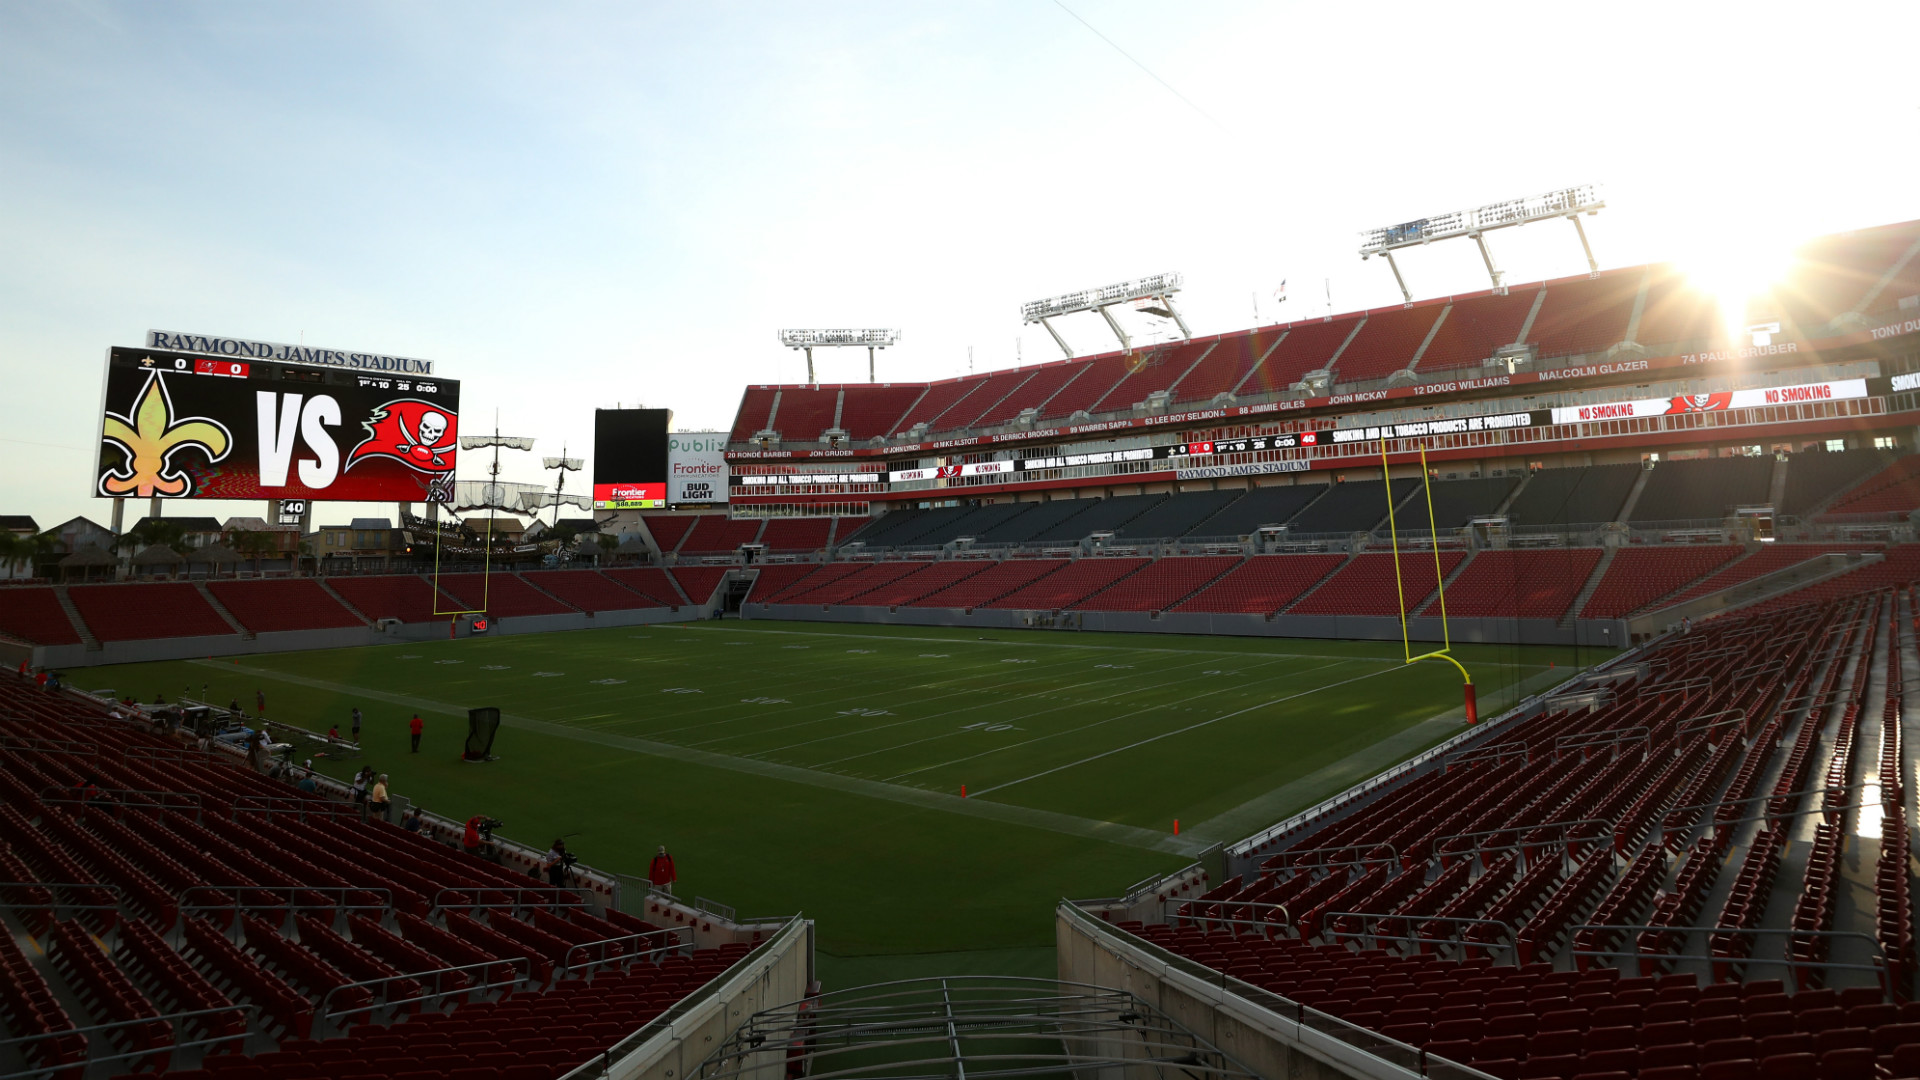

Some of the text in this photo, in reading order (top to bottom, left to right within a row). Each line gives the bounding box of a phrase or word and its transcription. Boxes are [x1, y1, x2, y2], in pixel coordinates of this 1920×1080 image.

[1871, 323, 1901, 340] TONY
[153, 332, 433, 375] RAYMOND JAMES STADIUM
[1682, 343, 1798, 366] 74 PAUL GRUBER
[175, 359, 186, 370] 0
[230, 364, 241, 375] 0
[1539, 360, 1649, 382] MALCOLM GLAZER
[379, 381, 390, 389] 10
[397, 383, 410, 391] 25
[416, 385, 437, 393] 0:00
[1414, 376, 1510, 396] 12 DOUG WILLIAMS
[1329, 390, 1388, 405] JOHN MCKAY
[1765, 385, 1832, 404] NO SMOKING
[1239, 400, 1306, 415] 88 JIMMIE GILES
[1579, 403, 1634, 421] NO SMOKING
[1155, 415, 1169, 424] LEE
[1170, 413, 1187, 423] ROY
[1188, 410, 1220, 421] SELMON
[1079, 422, 1107, 432] WARREN
[1109, 420, 1127, 429] SAPP
[1333, 413, 1531, 443] SMOKING AND ALL TOBACCO PRODUCTS ARE PROHIBITED
[256, 390, 342, 489] VS
[1001, 432, 1027, 441] DERRICK
[1028, 430, 1054, 439] BROOKS
[1302, 435, 1315, 443] 40
[955, 437, 979, 447] ALSTOTT
[1235, 443, 1246, 451] 10
[1253, 441, 1266, 449] 25
[1274, 438, 1295, 447] 0:00
[728, 451, 736, 459] 20
[763, 450, 792, 459] BARBER
[809, 449, 854, 458] JON GRUDEN
[674, 462, 722, 474] Frontier
[1178, 460, 1309, 480] RAYMOND JAMES STADIUM
[612, 487, 646, 497] Frontier
[682, 491, 714, 499] LIGHT
[286, 502, 303, 513] 40
[474, 620, 486, 630] 40
